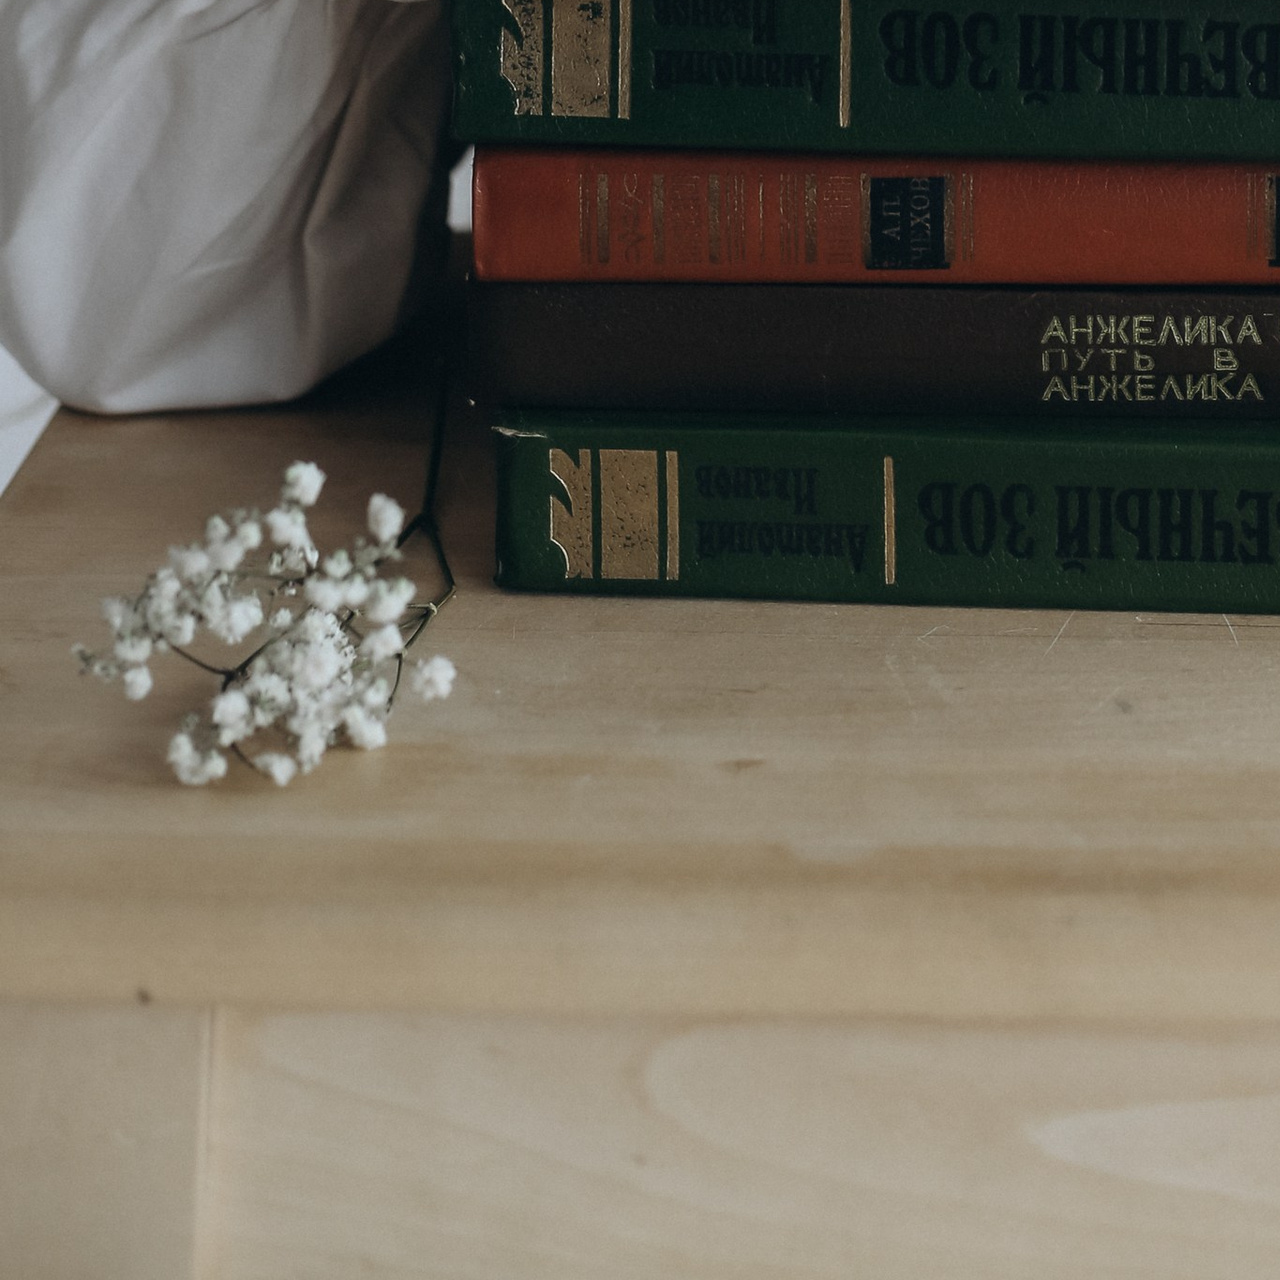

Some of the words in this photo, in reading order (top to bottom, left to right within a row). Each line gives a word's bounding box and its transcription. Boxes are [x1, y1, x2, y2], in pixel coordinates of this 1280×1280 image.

[651, 47, 833, 104] Анатолий
[877, 9, 1002, 92] ЗОВ
[909, 177, 932, 262] ЧЕХОВ
[1040, 314, 1263, 346] АНЖЕЛИКА
[1041, 348, 1155, 372] ПУТЬ
[1213, 347, 1239, 371] В
[1041, 372, 1264, 402] АНЖЕЛИКА
[694, 466, 818, 515] Иванов
[694, 520, 870, 573] Анатолий
[916, 481, 1038, 561] ЗОВ
